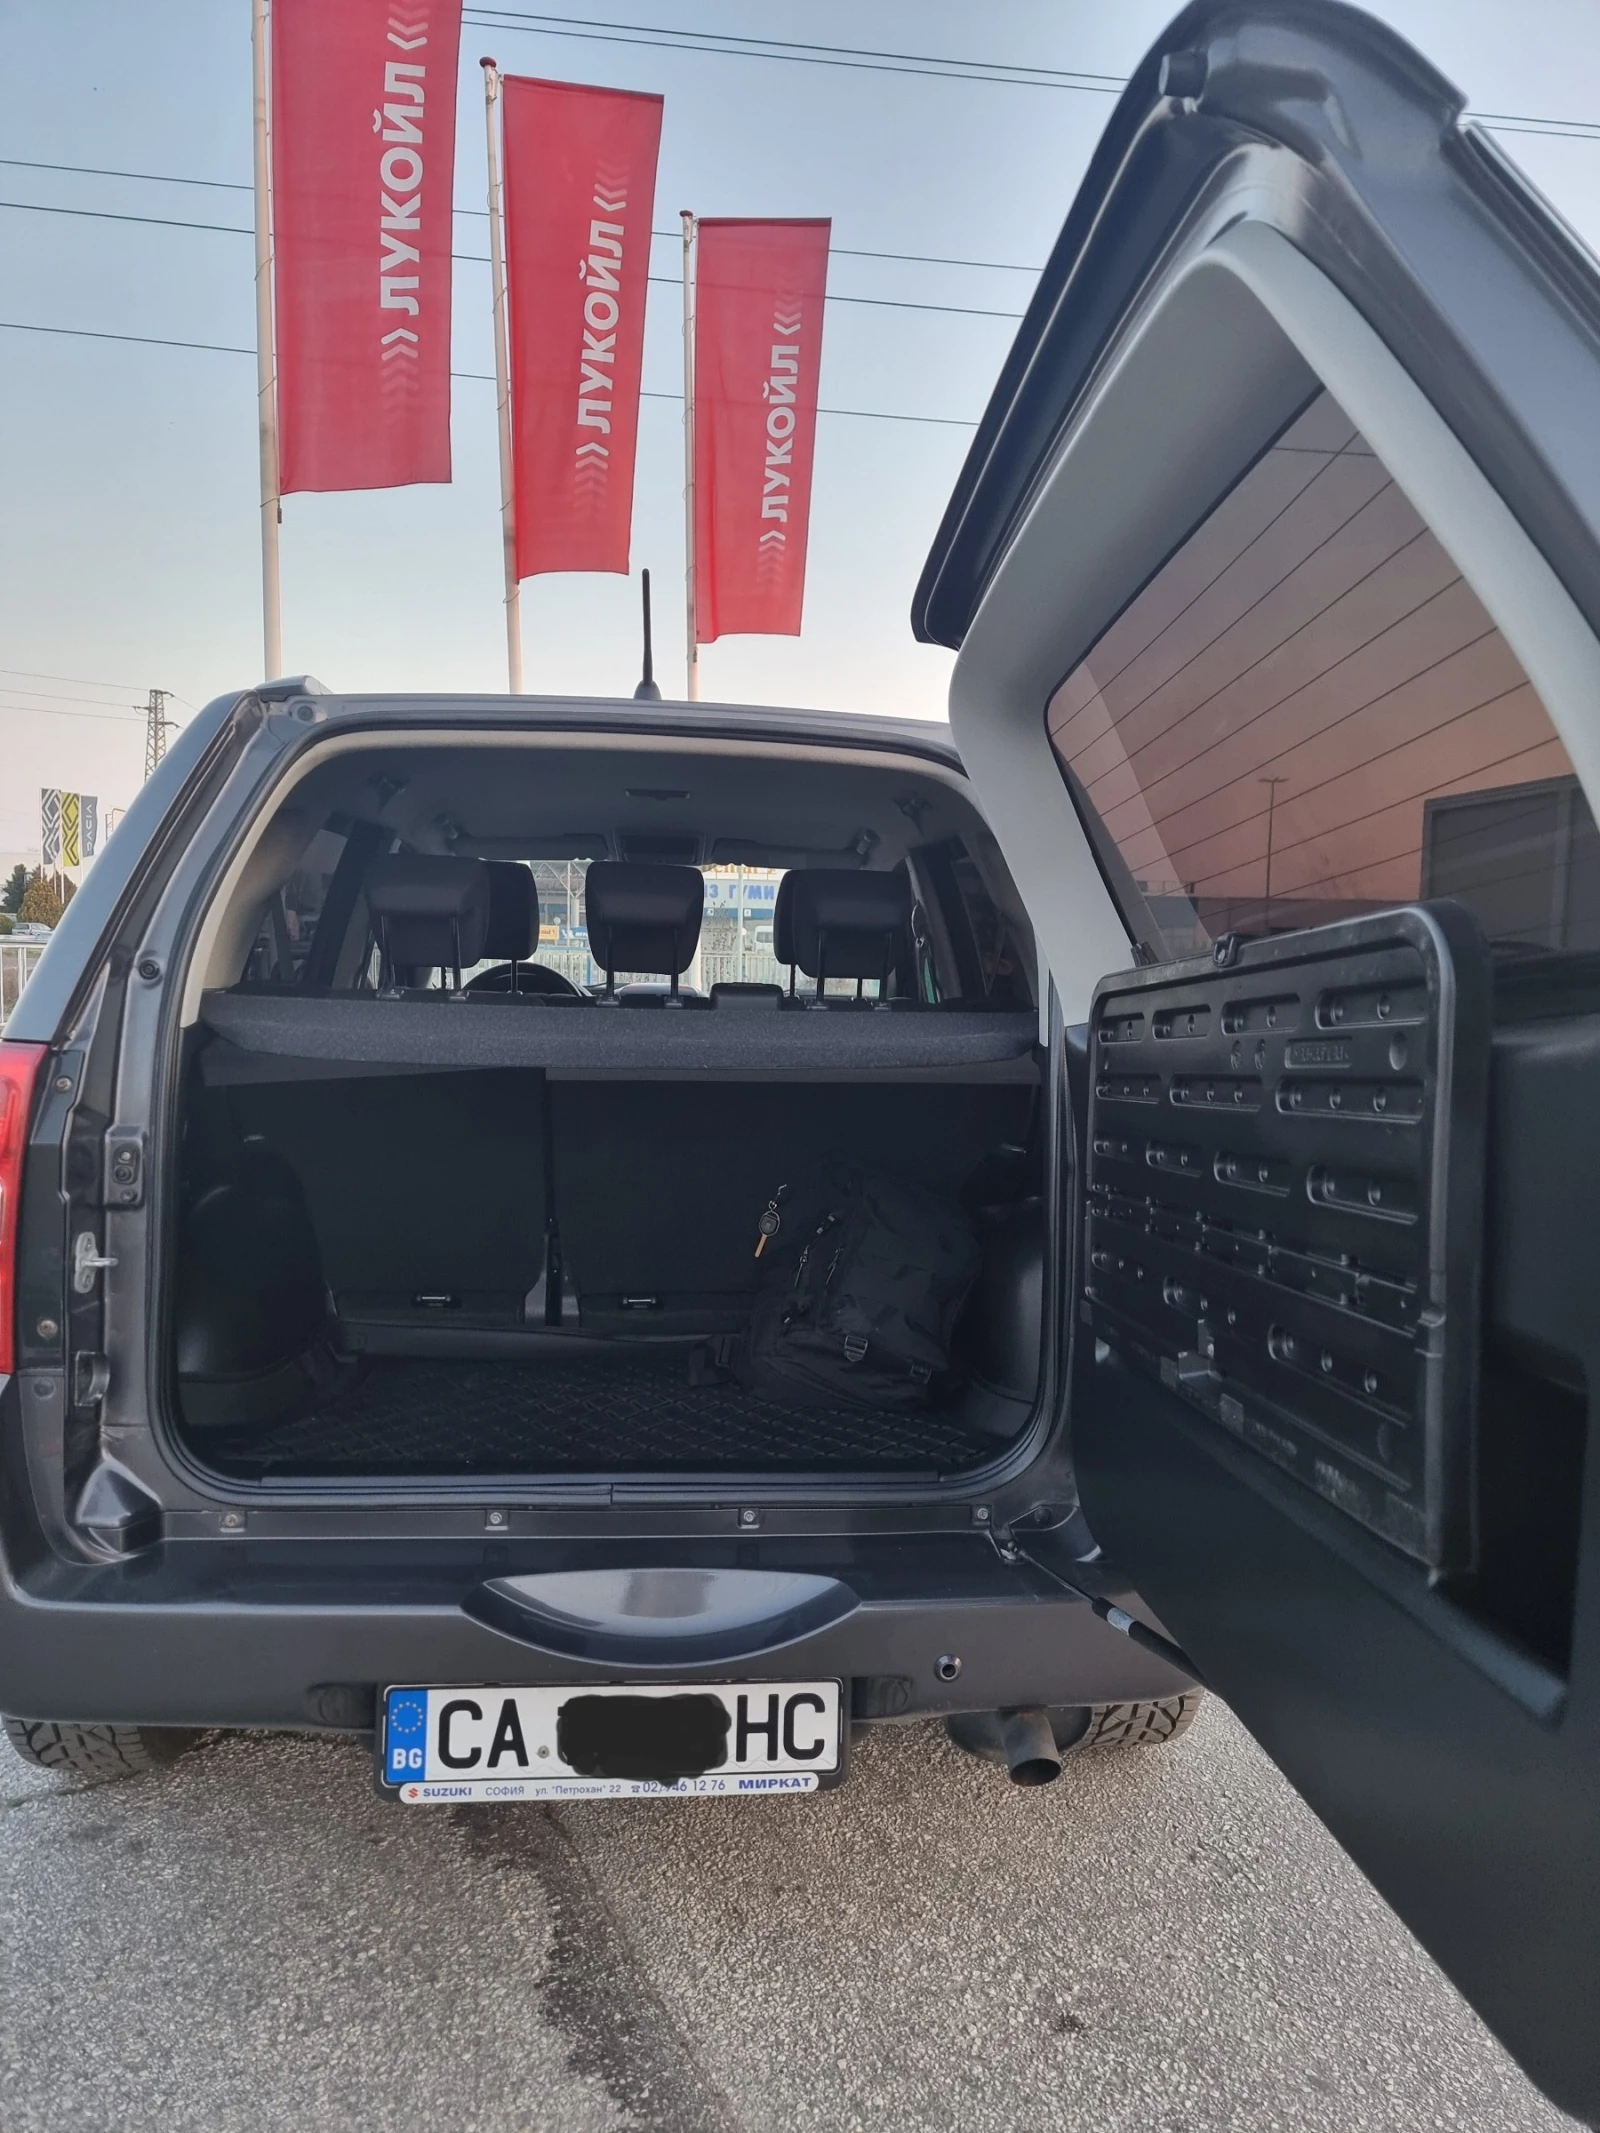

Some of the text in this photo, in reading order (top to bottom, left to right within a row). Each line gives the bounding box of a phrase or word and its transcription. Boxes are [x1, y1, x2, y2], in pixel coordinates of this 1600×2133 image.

[373, 61, 426, 315] ЛУКОЙЛ
[576, 219, 626, 434] ЛУКОЙЛ
[761, 344, 800, 522] ЛУКОЙЛ
[392, 1747, 422, 1770] BG
[423, 1787, 472, 1797] SUZUKI
[485, 1786, 525, 1796] СОФИЯ
[535, 1787, 549, 1797] ул.
[609, 1784, 621, 1793] 22
[693, 1780, 707, 1792] 12
[711, 1779, 726, 1791] 76
[738, 1777, 812, 1790] МИРКАТ
